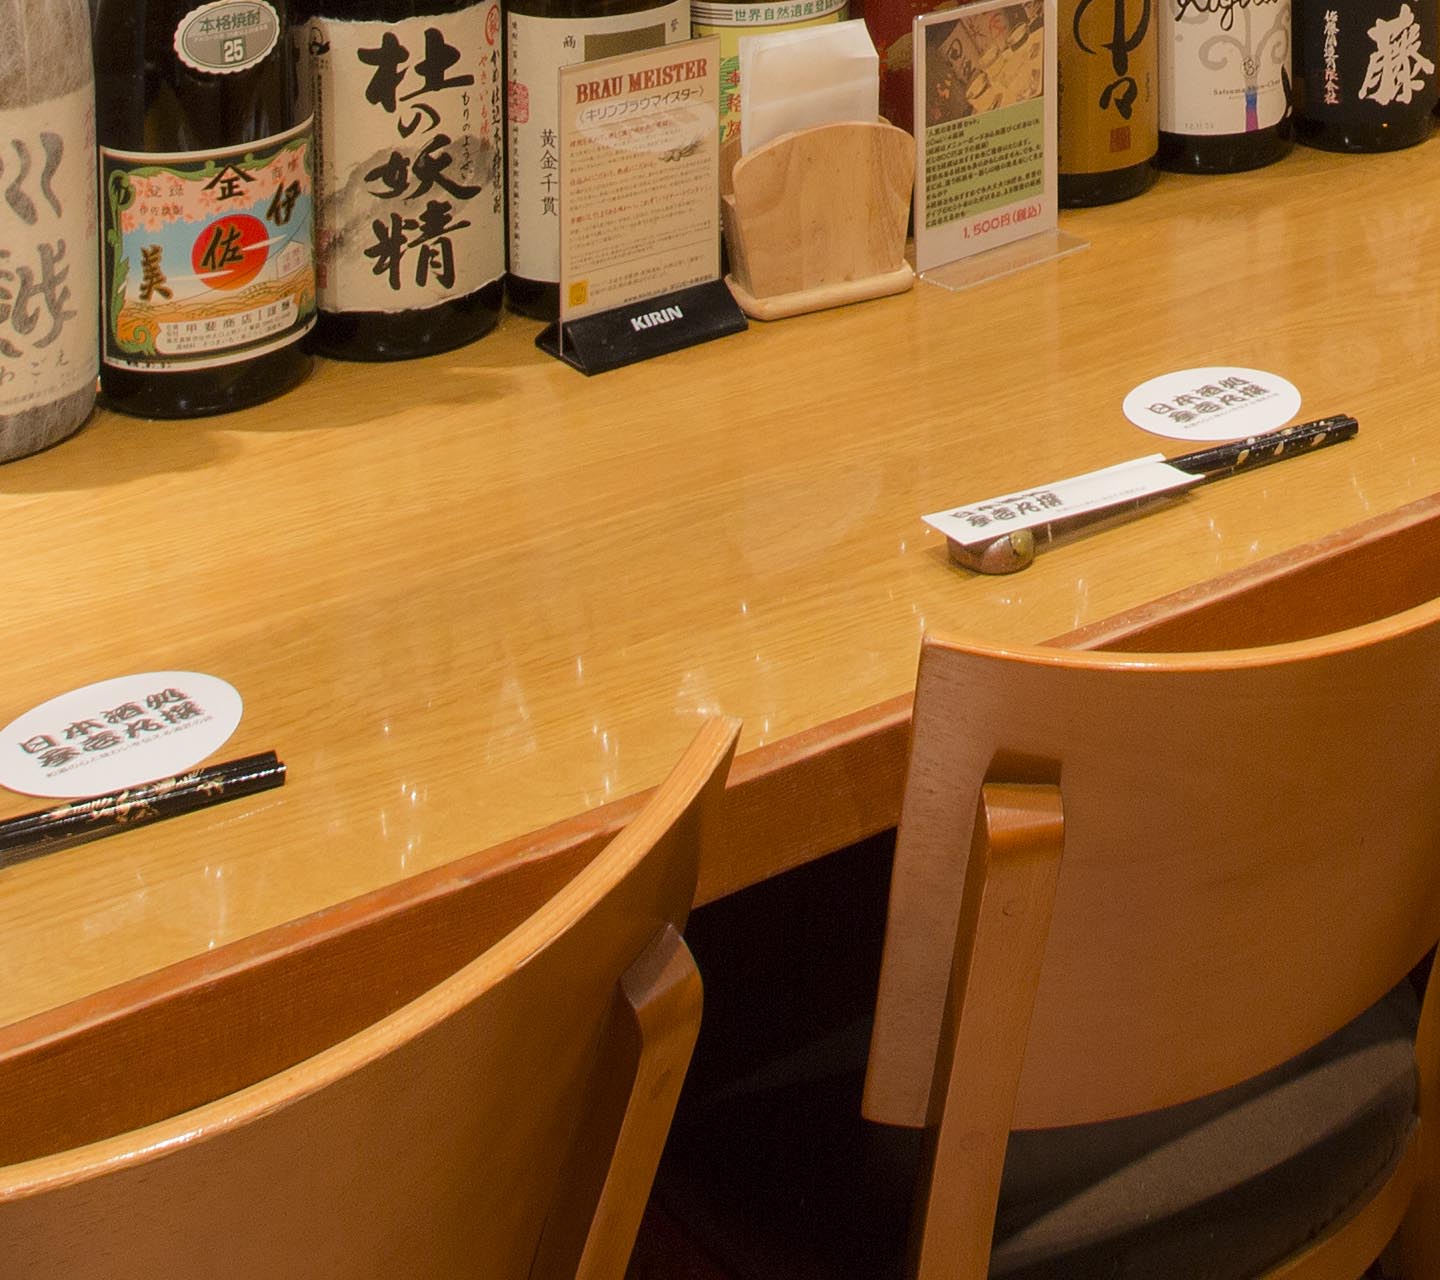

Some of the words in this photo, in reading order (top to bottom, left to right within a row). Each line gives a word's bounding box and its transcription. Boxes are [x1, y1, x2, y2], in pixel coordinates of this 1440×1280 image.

[199, 10, 262, 34] 本格焼酎
[223, 39, 246, 63] 25
[1323, 9, 1340, 105] 佐藤酒造有限会社
[575, 75, 623, 105] BRAU
[628, 58, 709, 93] MEISTER
[357, 27, 482, 291] 杜の妖精
[540, 129, 558, 217] 黄金千貫
[630, 305, 684, 332] KIRIN
[1148, 375, 1251, 417] 日本酒処
[18, 686, 193, 756] 日本酒処
